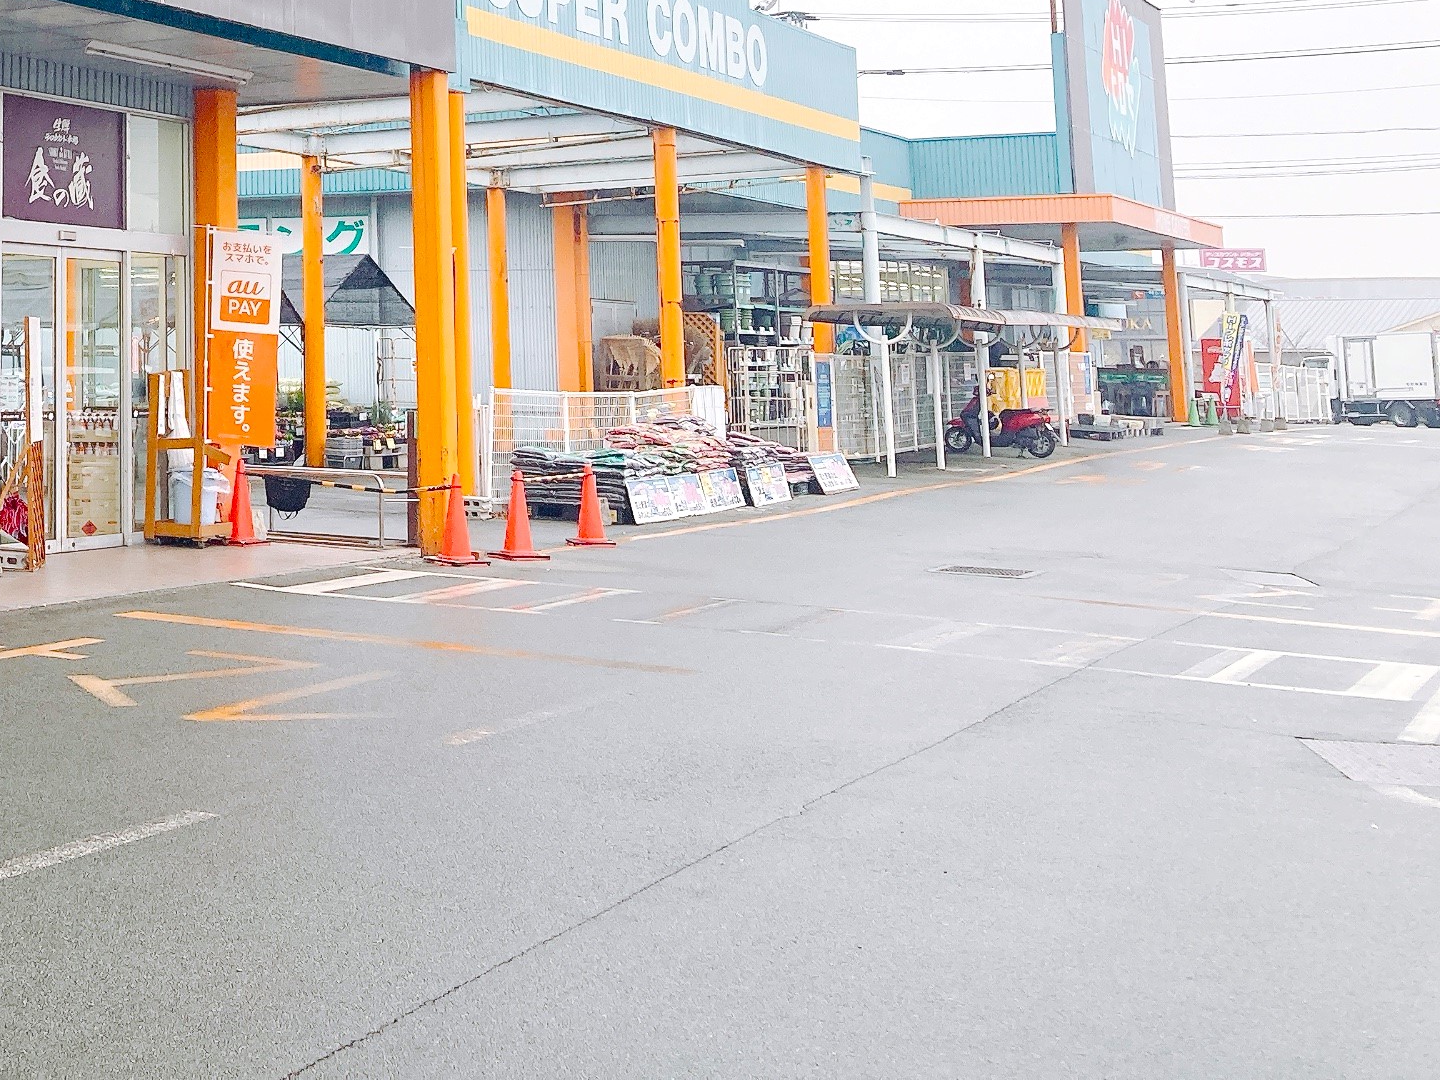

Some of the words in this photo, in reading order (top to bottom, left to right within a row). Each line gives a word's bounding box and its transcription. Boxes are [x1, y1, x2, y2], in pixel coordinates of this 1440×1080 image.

[222, 240, 273, 257] お支払いを
[1206, 257, 1263, 269] コスモス
[227, 278, 265, 296] au
[228, 298, 262, 317] PAY
[230, 338, 255, 433] 使えます。
